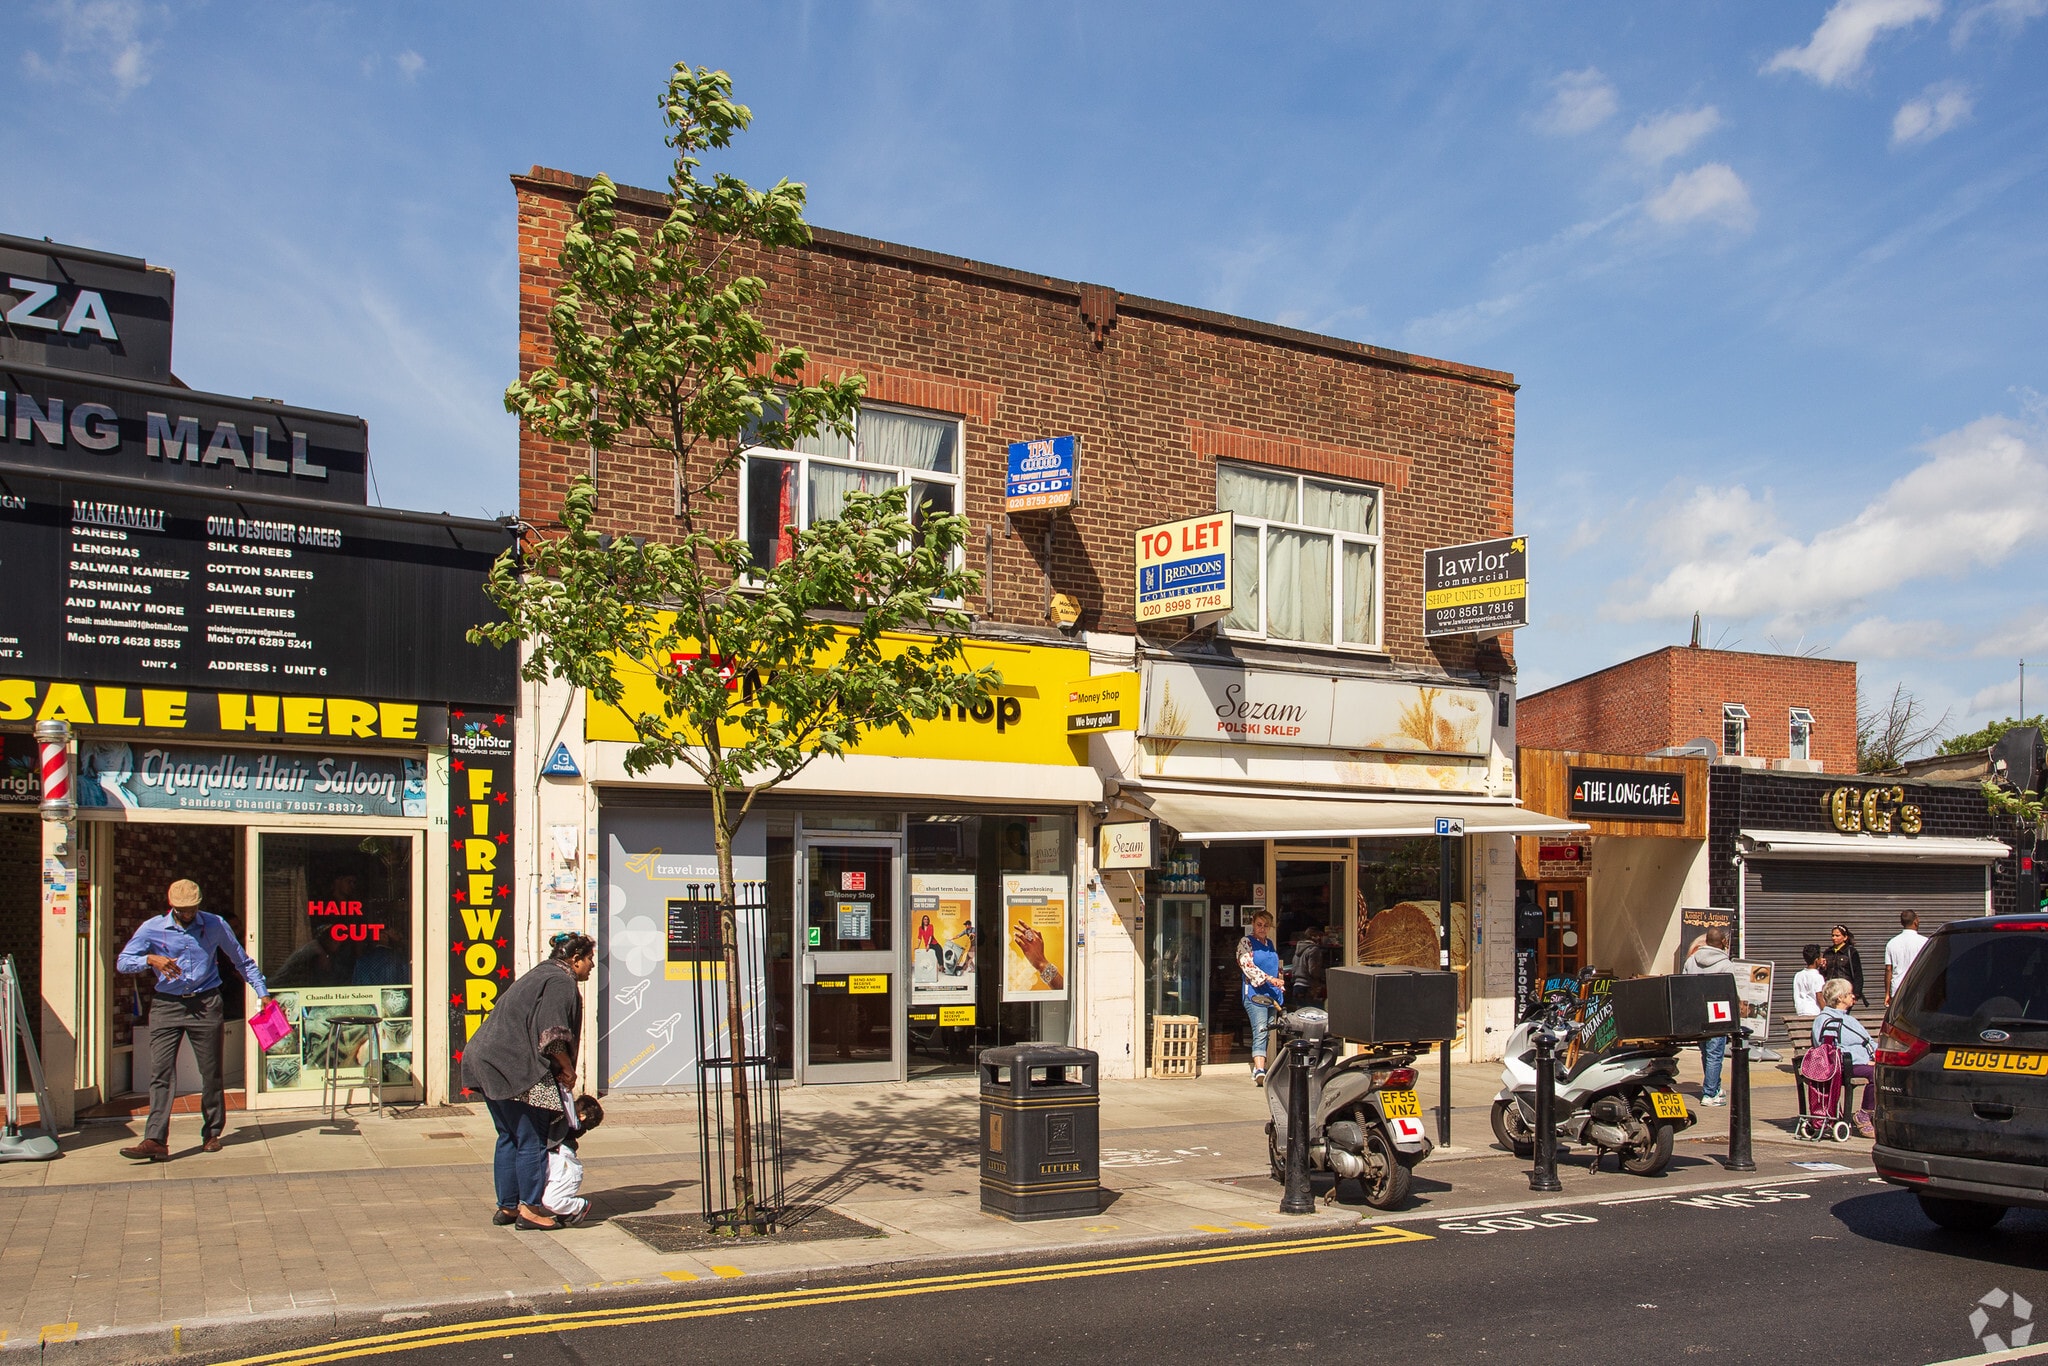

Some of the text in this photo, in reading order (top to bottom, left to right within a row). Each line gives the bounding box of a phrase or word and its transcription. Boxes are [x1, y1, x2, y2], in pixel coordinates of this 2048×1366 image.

[0, 277, 119, 340] ZA
[147, 411, 327, 478] MALL
[1028, 440, 1054, 458] TPM
[1017, 480, 1062, 494] SOLD
[1010, 493, 1069, 508] 020 8759 2007
[72, 500, 165, 531] MAKHAMALI
[72, 526, 127, 540] SAREES
[207, 515, 342, 548] OVIA DESIGNER SAREES
[1142, 520, 1223, 560] TO LET
[72, 543, 140, 558] LENGHAS
[207, 542, 292, 558] SILK SAREES
[69, 561, 190, 580] SALWAR KAMEEZ
[207, 563, 314, 580] COTTON SAREES
[1165, 560, 1222, 583] BRENDONS
[1438, 550, 1509, 577] lawlor
[69, 579, 152, 594] PASHMINAS
[1437, 570, 1509, 588] commercial
[207, 582, 295, 598] SALWAR SUIT
[1145, 584, 1218, 601] COMMERCIAL
[1427, 583, 1523, 606] SHOP UNITS TO LET
[65, 597, 185, 616] AND MANY MORE
[206, 604, 296, 618] JEWELLERIES
[1143, 594, 1221, 616] 020 8998 7748
[1437, 601, 1514, 620] 020 8561 7816
[66, 615, 92, 625] E-mail:
[67, 632, 181, 649] Mob: 078 4628 8555
[207, 633, 312, 649] Mob: 074 6289 5241
[16, 650, 23, 658] 2
[142, 660, 168, 669] UNIT
[208, 660, 269, 672] ADDRESS
[284, 665, 316, 675] UNIT
[319, 667, 327, 676] 6
[676, 659, 731, 685] Te
[1078, 693, 1100, 704] Money
[1102, 690, 1119, 701] Shop
[1216, 684, 1307, 722] Sezam
[0, 679, 418, 740] SALE HERE
[1076, 713, 1112, 728] We buy gold
[1217, 722, 1301, 736] POLSKI SKLEP
[452, 734, 511, 749] BrightStar
[142, 749, 397, 803] Chandla Hair Saloon
[1583, 781, 1670, 805] THE LONG CAFÉ
[180, 797, 364, 813] Sandeep Chandla 78057-88372
[1832, 786, 1922, 833] GG's
[1440, 821, 1447, 832] P
[1113, 834, 1145, 853] Sezam
[657, 864, 738, 878] travel moy
[834, 891, 857, 899] Money
[308, 901, 363, 916] HAIR
[330, 924, 384, 941] CUT
[1713, 1003, 1726, 1019] L
[1986, 1032, 2001, 1040] Ford
[629, 1043, 656, 1068] money
[1952, 1051, 2042, 1071] BG09 LGJ
[1382, 1092, 1417, 1103] EF55
[1657, 1095, 1680, 1104] AP15
[1390, 1104, 1417, 1116] VNZ
[1660, 1106, 1682, 1116] RXM
[1398, 1120, 1418, 1135] L
[1041, 1163, 1080, 1174] LITTER
[1438, 1212, 1599, 1235] SOLO
